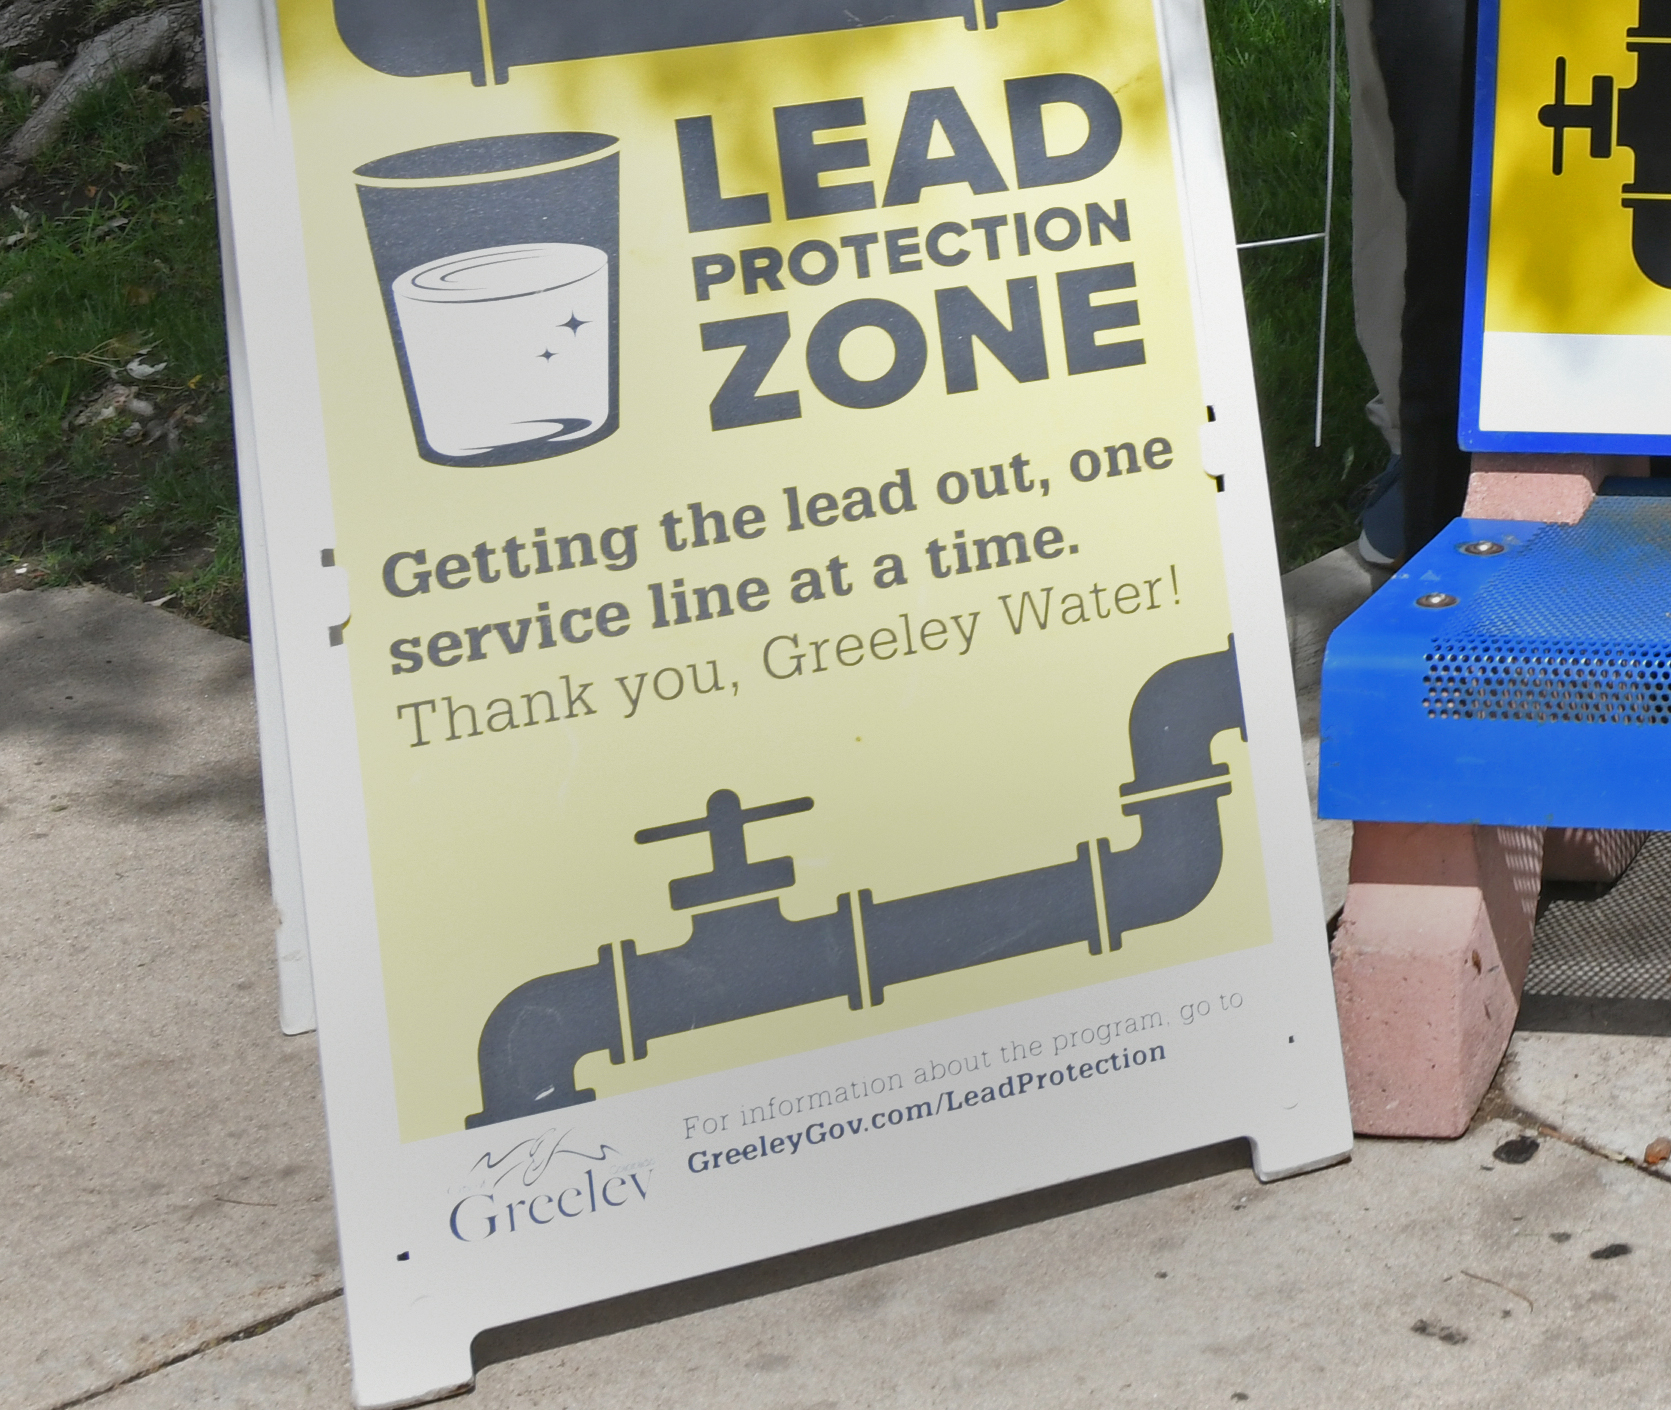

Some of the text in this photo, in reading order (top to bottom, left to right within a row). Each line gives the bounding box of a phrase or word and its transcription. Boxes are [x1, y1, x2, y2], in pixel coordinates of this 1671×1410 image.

[675, 73, 1123, 233] LEAD
[692, 198, 1131, 301] PROTECTION
[700, 263, 1147, 432] ZONE
[382, 437, 1173, 597] Getting the lead out, one
[389, 526, 1078, 674] service line at a time.
[396, 564, 1179, 747] Thank you, Greeley Water!
[688, 1045, 1164, 1172] GreeleyGov.com/LeadProtection
